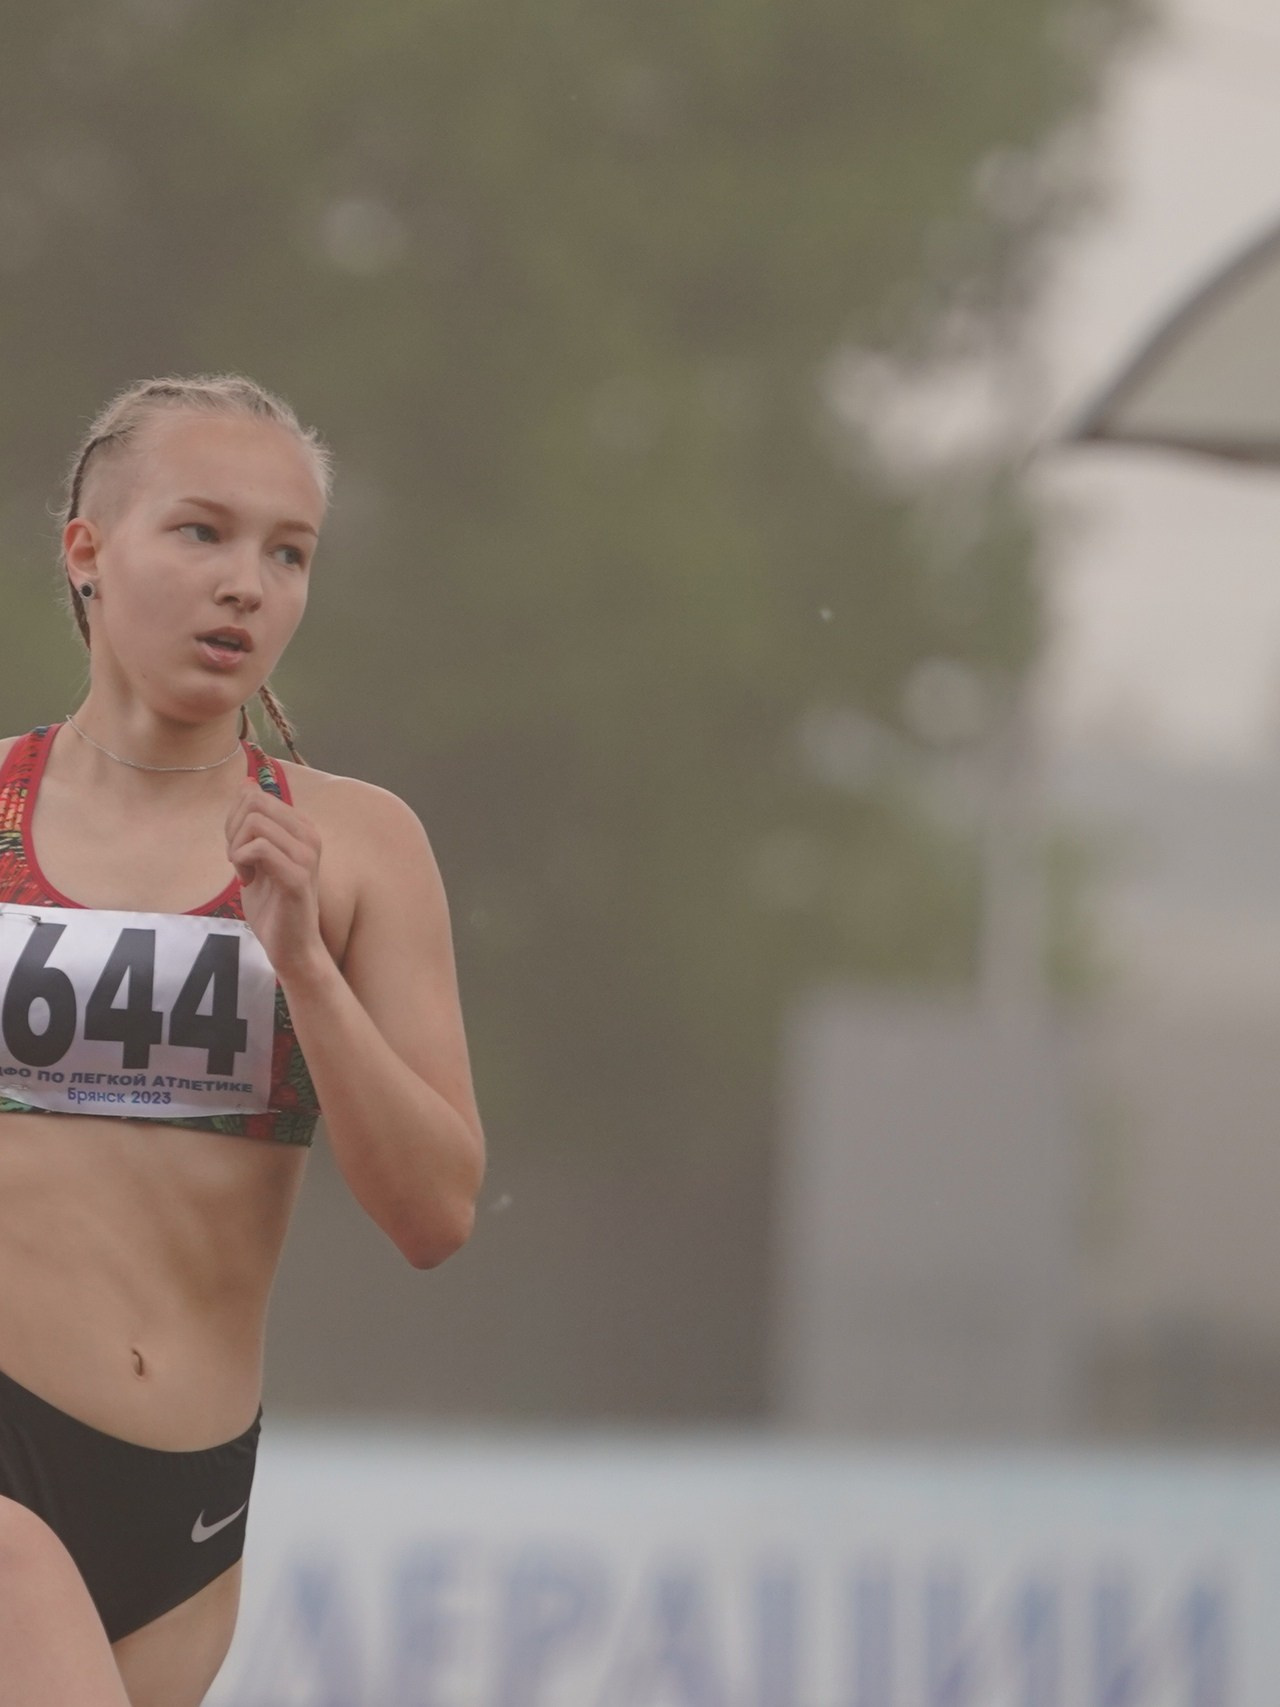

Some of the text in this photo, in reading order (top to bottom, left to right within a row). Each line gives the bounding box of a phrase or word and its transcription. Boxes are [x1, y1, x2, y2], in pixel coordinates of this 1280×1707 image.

[2, 922, 248, 1076] 644
[37, 1070, 65, 1083] ПО
[69, 1072, 147, 1086] ЛЕГКОЙ
[152, 1075, 253, 1093] АТЛЕТИКЕ
[67, 1087, 172, 1104] Брянск 2023
